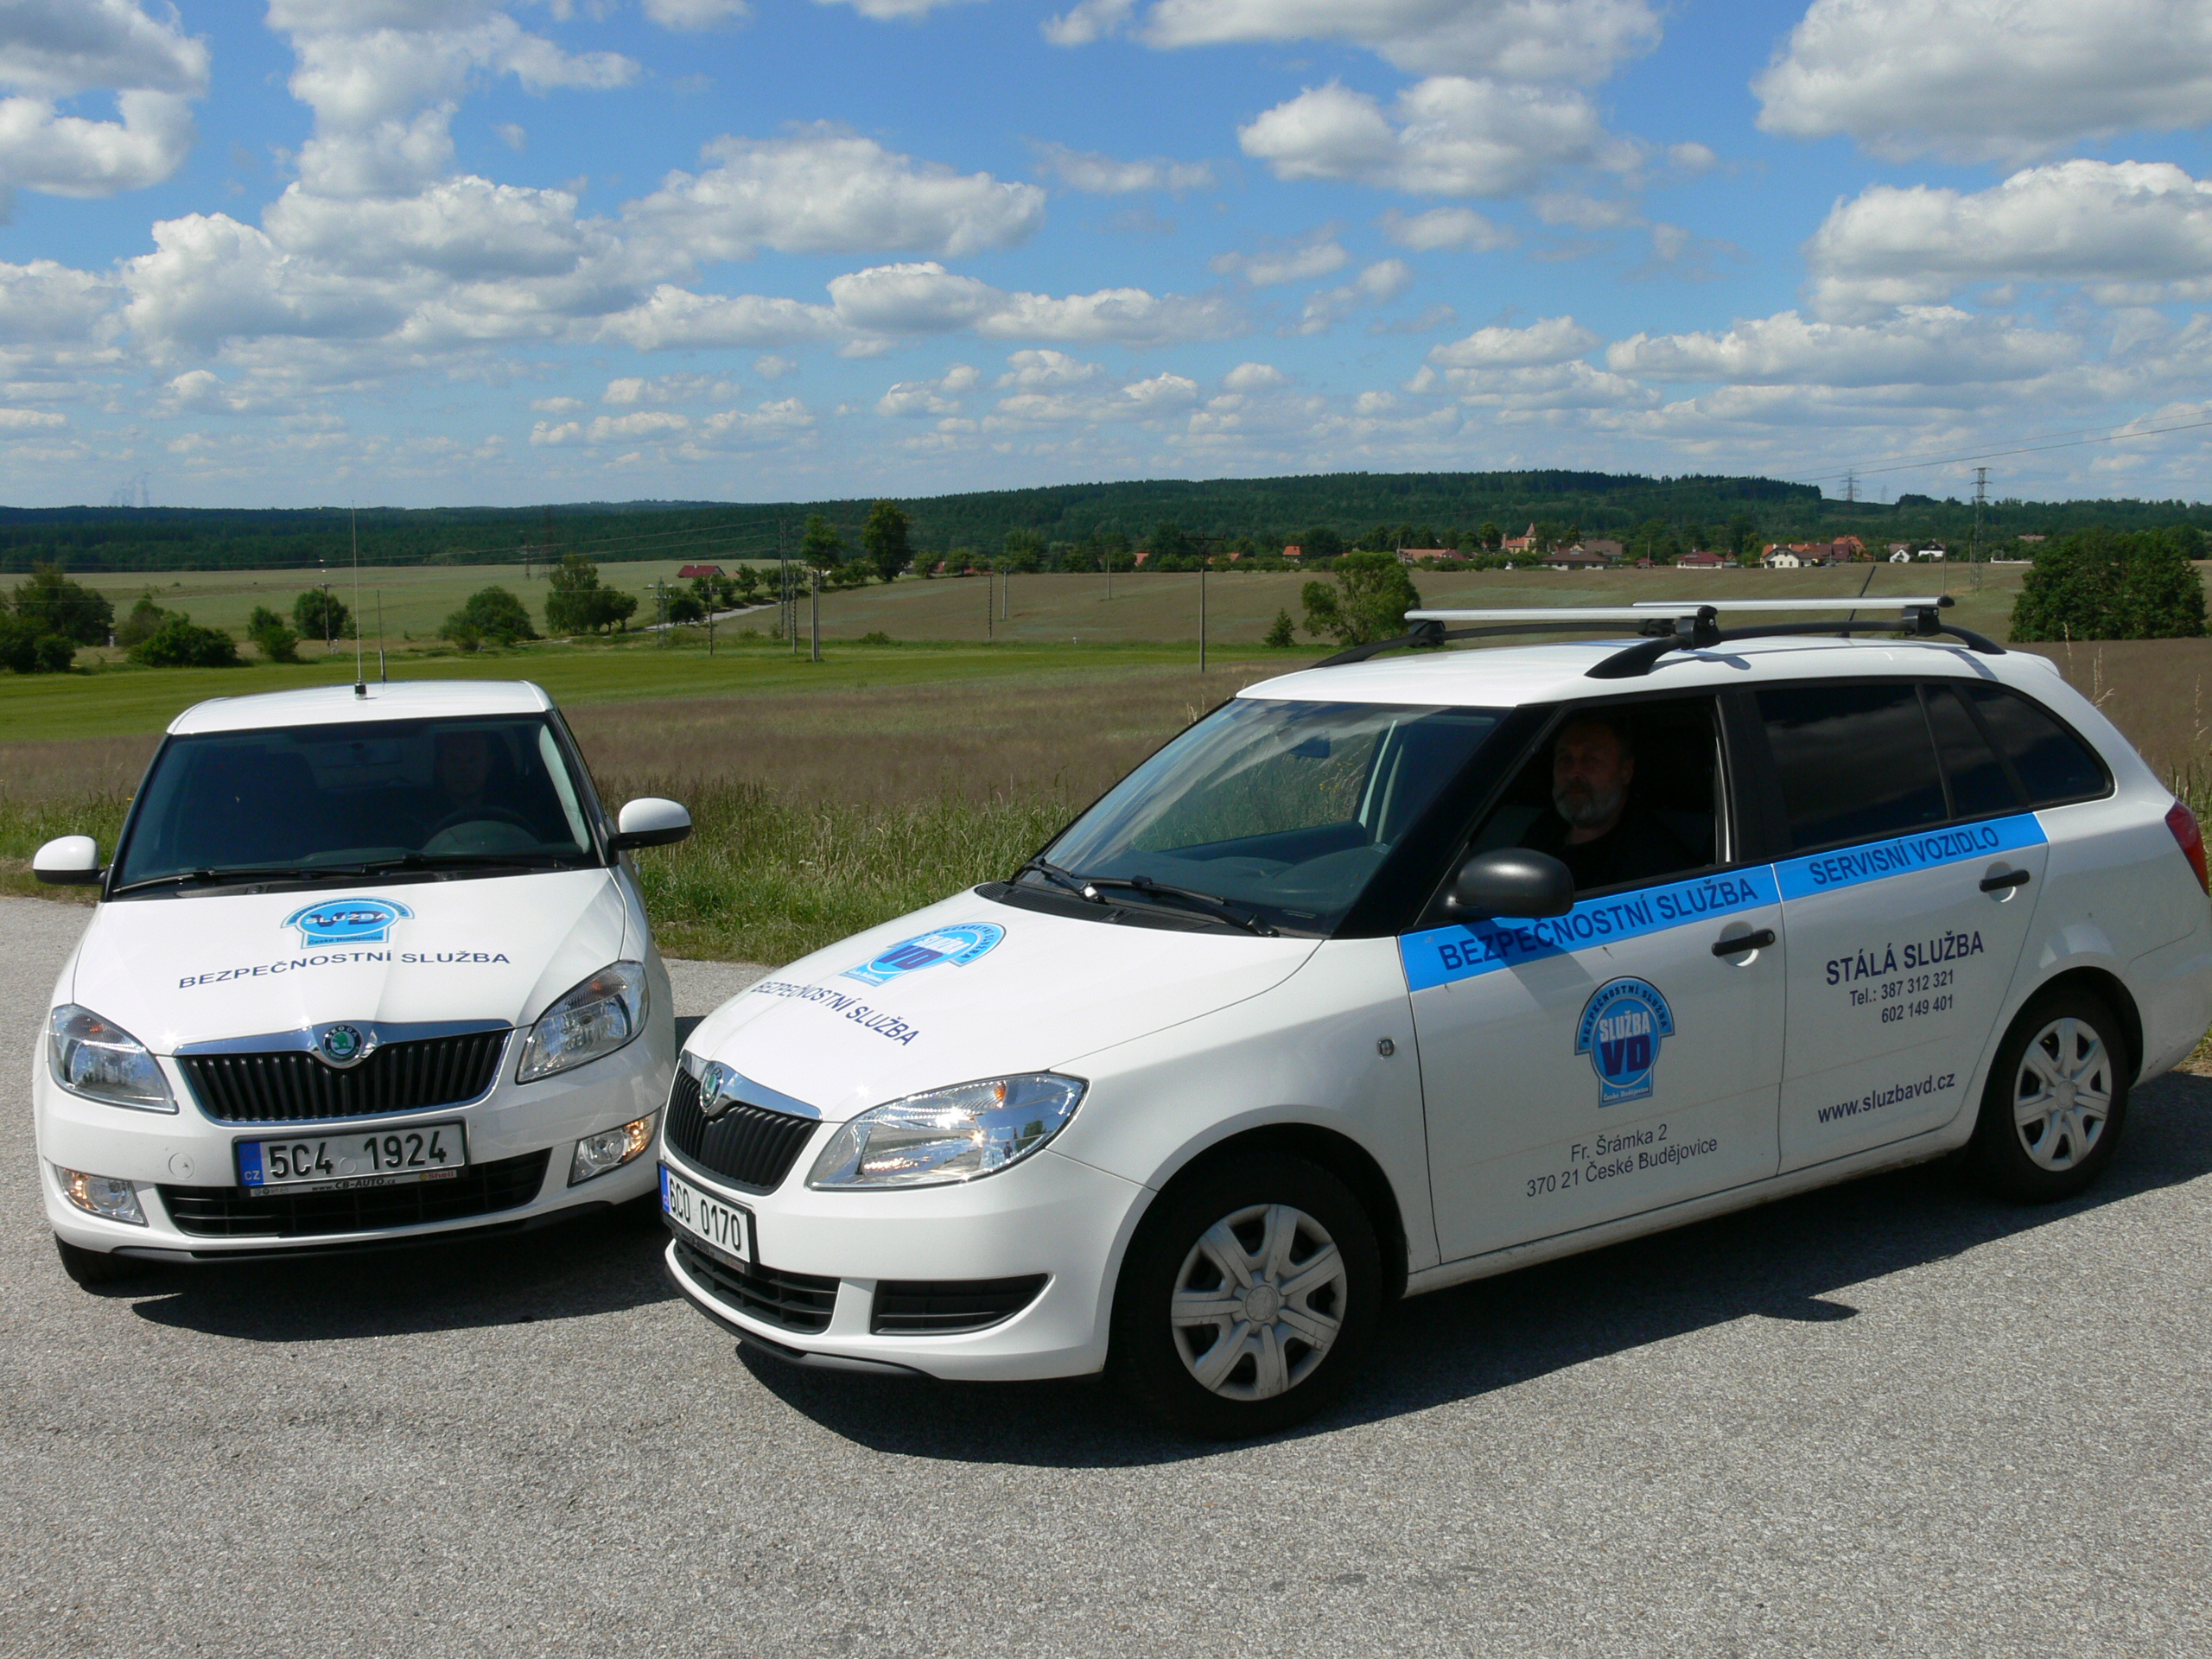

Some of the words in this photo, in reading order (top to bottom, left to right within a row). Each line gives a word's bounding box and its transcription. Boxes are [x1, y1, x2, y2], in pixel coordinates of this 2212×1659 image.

[1808, 838, 1911, 885] SERVISNÍ
[1910, 826, 1999, 862] VOZIDLO
[1438, 893, 1654, 970] BEZPEČNOSTNÍ
[1656, 878, 1759, 920] SLUŽBA
[178, 950, 393, 989] BEZPEČNOSTNÍ
[401, 951, 511, 964] SLUŽBA
[1826, 942, 1897, 986] STÁLÁ
[1904, 930, 1984, 969] SLUŽBA
[1850, 988, 1877, 1006] Tel.:
[1881, 980, 1904, 1000] 387
[1907, 975, 1929, 994] 312
[1933, 969, 1955, 988] 321
[1881, 1004, 1904, 1024] 602
[1908, 999, 1929, 1018] 149
[1932, 994, 1954, 1013] 401
[750, 981, 862, 1013] BEZPEČNOSTNÍ
[845, 1005, 920, 1046] SLUŽBA
[1599, 1010, 1651, 1043] SLUŽBA
[1600, 1034, 1651, 1077] VD
[1817, 1073, 1955, 1123] www.sluzbavd.cz
[268, 1141, 334, 1179] 5C4
[363, 1130, 448, 1171] 1924
[1571, 1143, 1590, 1162] Fr.
[1596, 1129, 1654, 1156] Šrámka
[1658, 1123, 1667, 1141] 2
[245, 1170, 260, 1181] CZ
[428, 1171, 454, 1180] Shell
[1526, 1174, 1555, 1197] 370
[1560, 1169, 1580, 1190] 21
[1586, 1156, 1634, 1183] České
[1638, 1137, 1718, 1171] Budějovice
[701, 1198, 741, 1253] 0170
